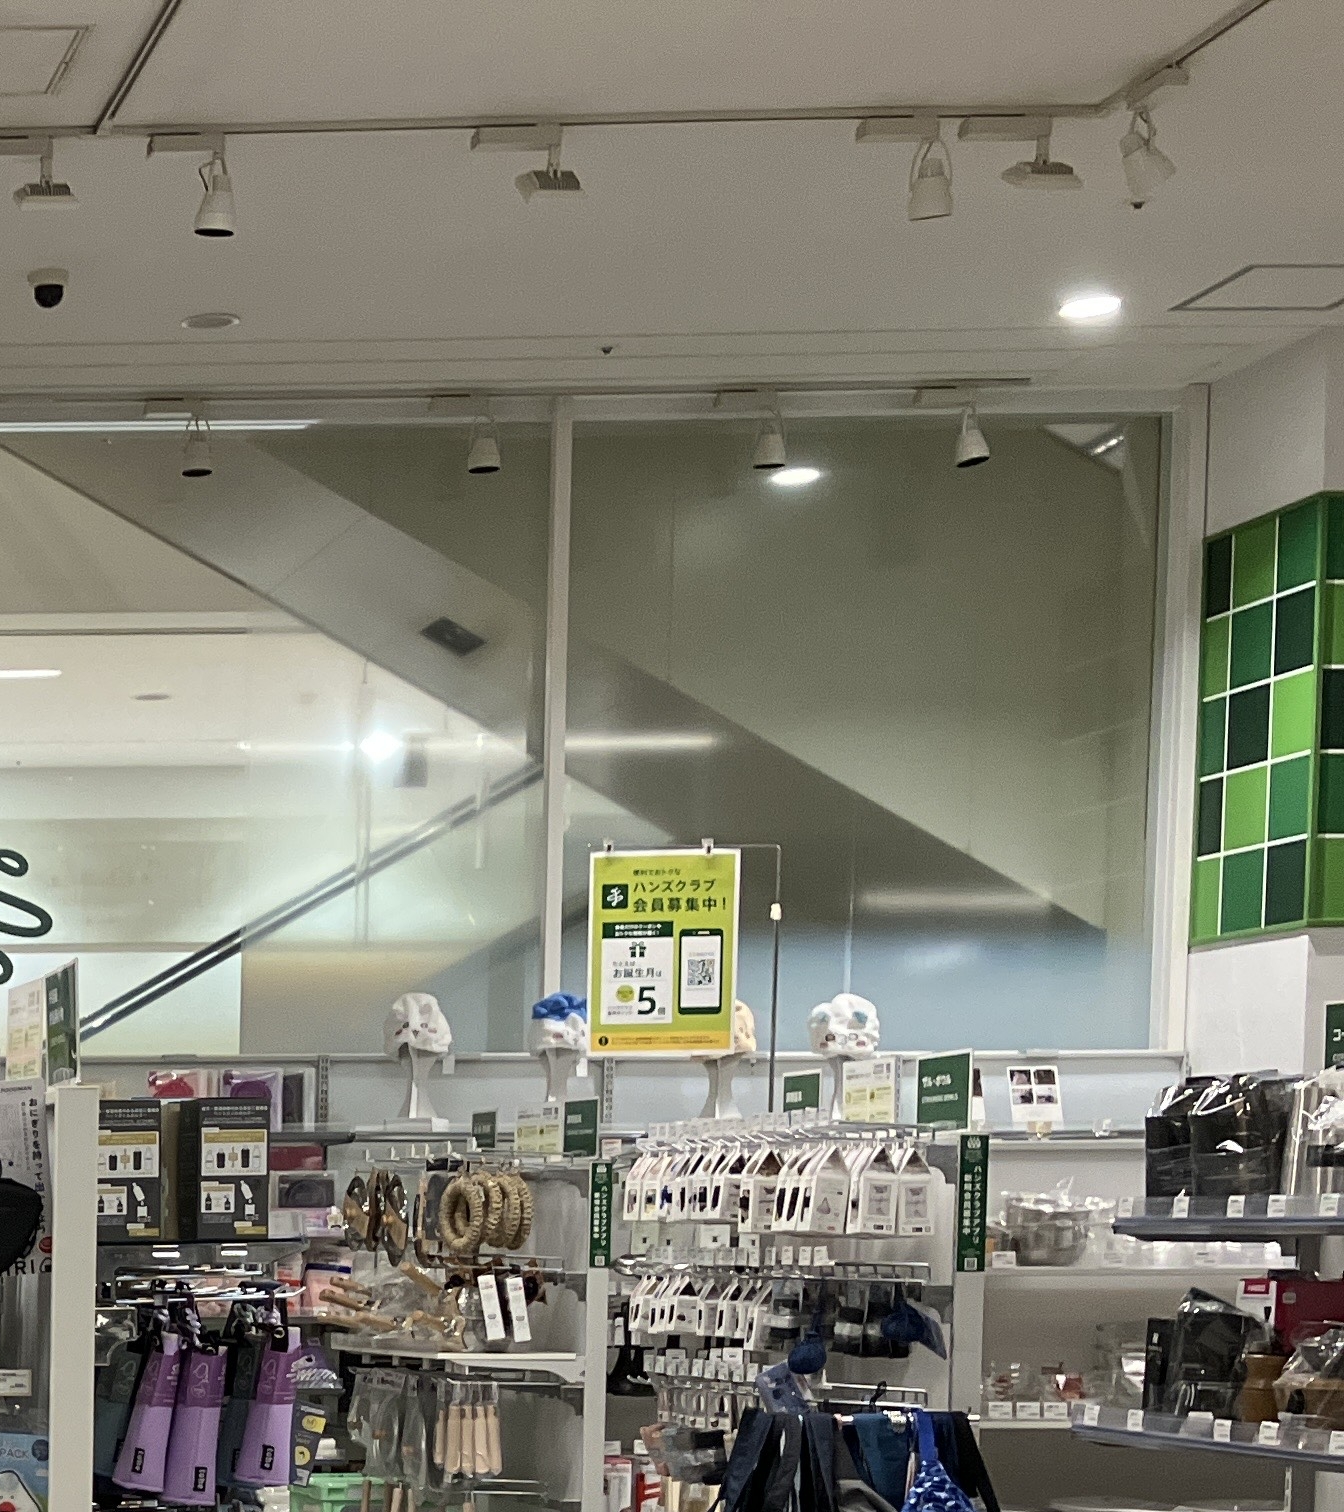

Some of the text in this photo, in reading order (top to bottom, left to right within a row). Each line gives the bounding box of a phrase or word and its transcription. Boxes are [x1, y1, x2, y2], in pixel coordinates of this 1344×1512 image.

[633, 879, 716, 893] ハンズクラブ
